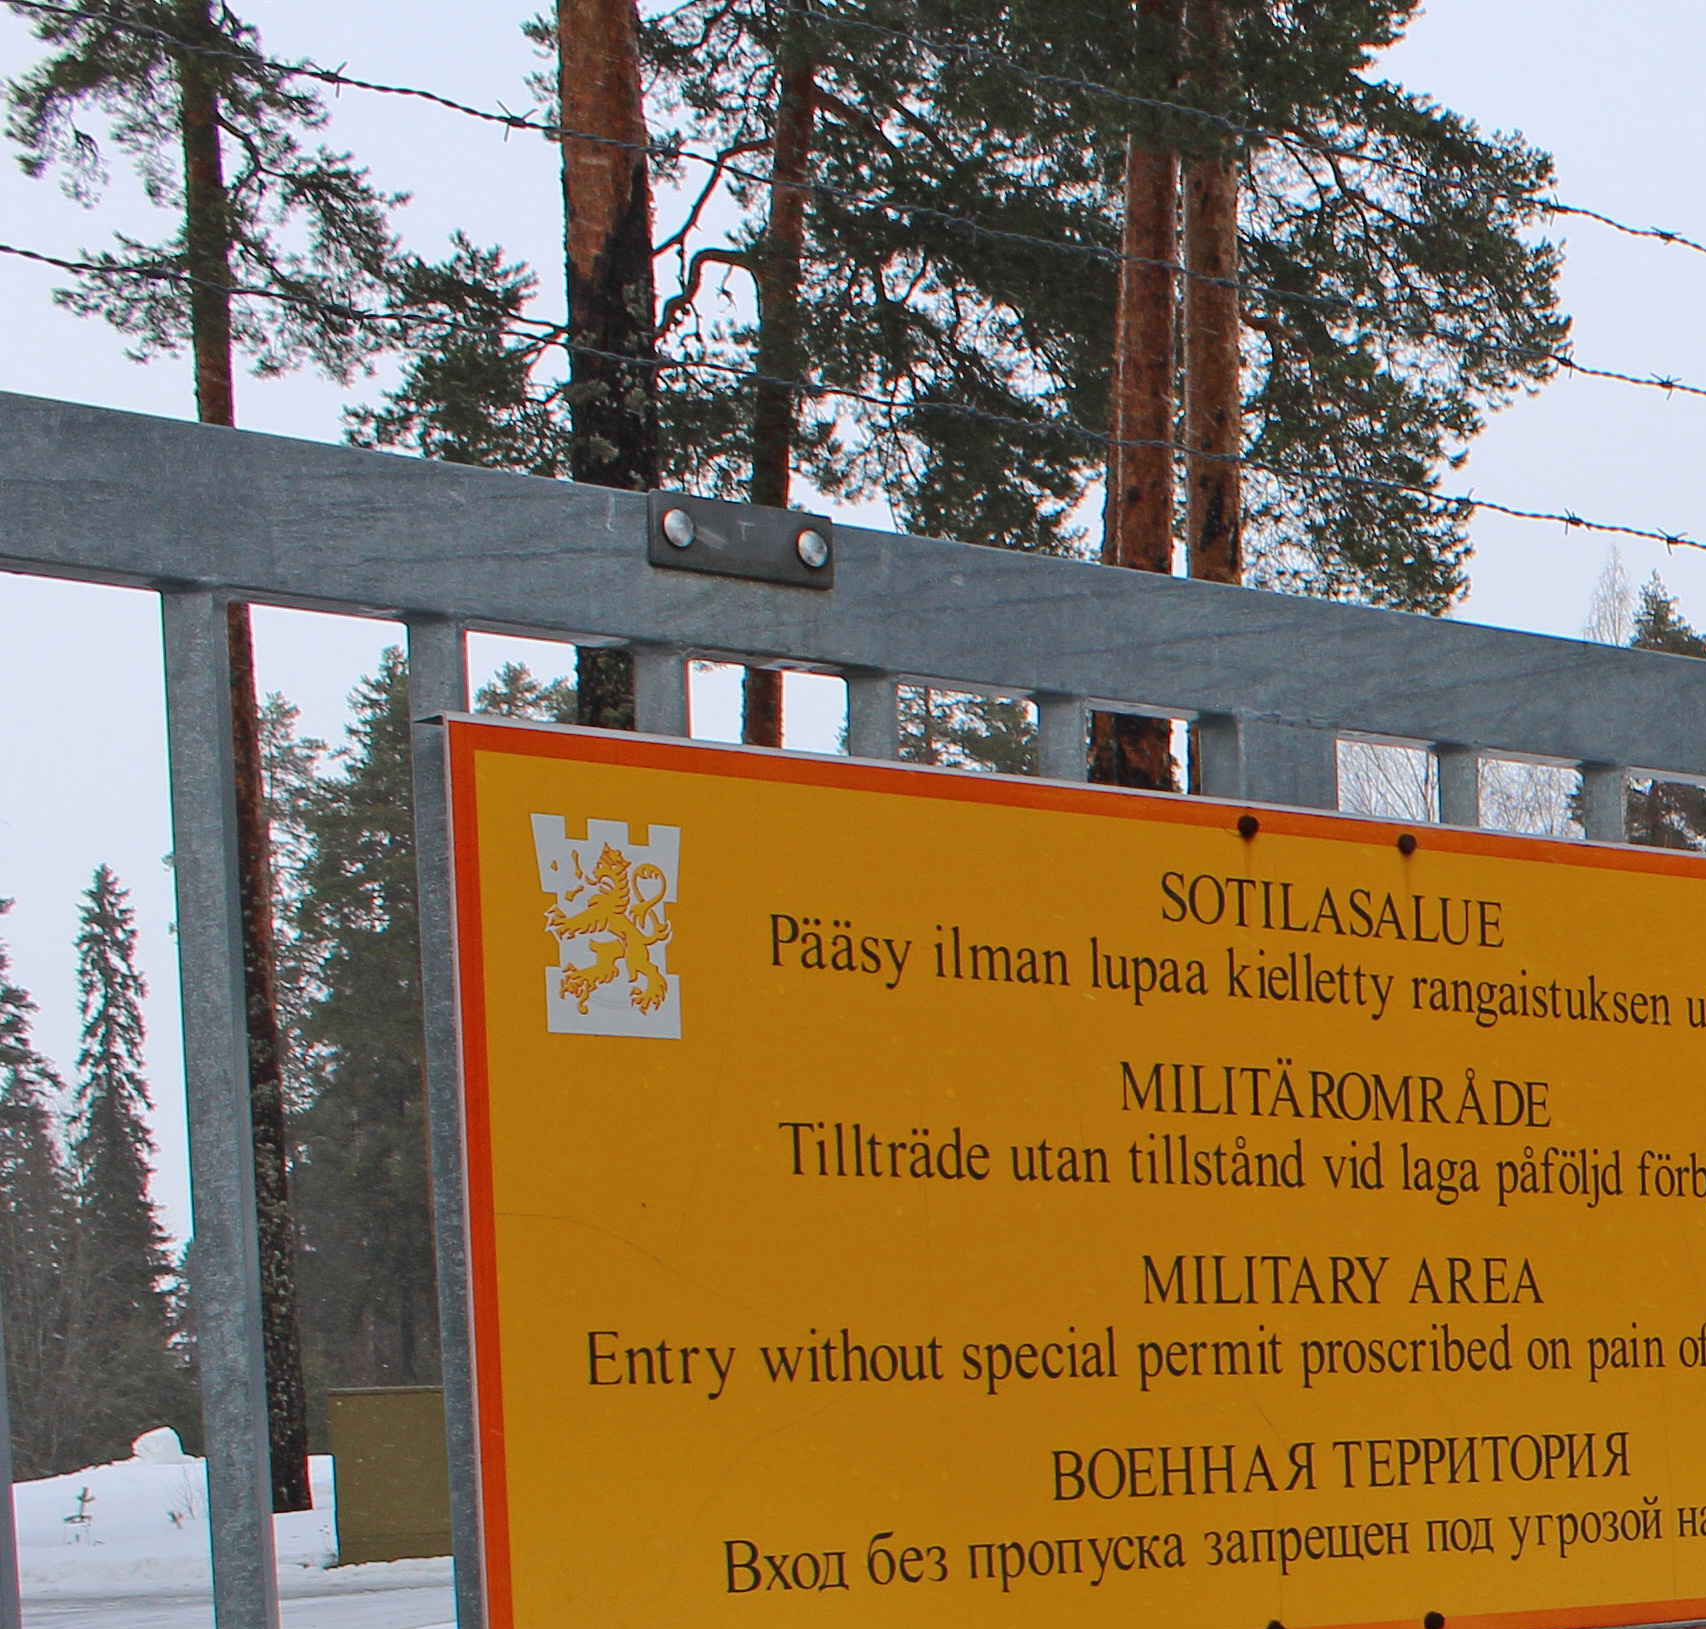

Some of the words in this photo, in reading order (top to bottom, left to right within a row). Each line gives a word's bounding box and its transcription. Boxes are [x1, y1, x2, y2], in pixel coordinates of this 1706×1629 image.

[1162, 872, 1504, 947] SOTILASALUE
[770, 914, 912, 989] Pääsy
[935, 925, 1069, 986] ilman
[1090, 937, 1208, 1006] lupaa
[1227, 947, 1394, 1020] kielletty
[1412, 970, 1671, 1028] rangaistuksen
[1120, 1058, 1551, 1127] MILITÄROMRÅDE
[779, 1122, 989, 1180] Tillträde
[1011, 1140, 1110, 1182] utan
[1129, 1133, 1305, 1188] tillstånd
[1323, 1140, 1384, 1190] vid
[1401, 1143, 1480, 1205] laga
[1496, 1146, 1623, 1208] påföljd
[1142, 1256, 1389, 1304] MILITARY
[1409, 1258, 1544, 1303] AREA
[588, 1331, 735, 1400] Entry
[760, 1328, 943, 1382] without
[963, 1326, 1118, 1395] special
[1138, 1325, 1282, 1391] permit
[1300, 1323, 1512, 1388] proscribed
[1528, 1338, 1571, 1370] on
[1587, 1322, 1665, 1382] pain
[1052, 1443, 1316, 1500] ВОЕННАЯ
[1333, 1432, 1630, 1488] ТЕРРИТОРИЯ
[724, 1540, 849, 1593] Вход
[868, 1532, 948, 1585] без
[968, 1534, 1186, 1589] пропуска
[1205, 1522, 1409, 1575] запрещен
[1426, 1518, 1494, 1553] под
[1509, 1496, 1662, 1561] угрозой
